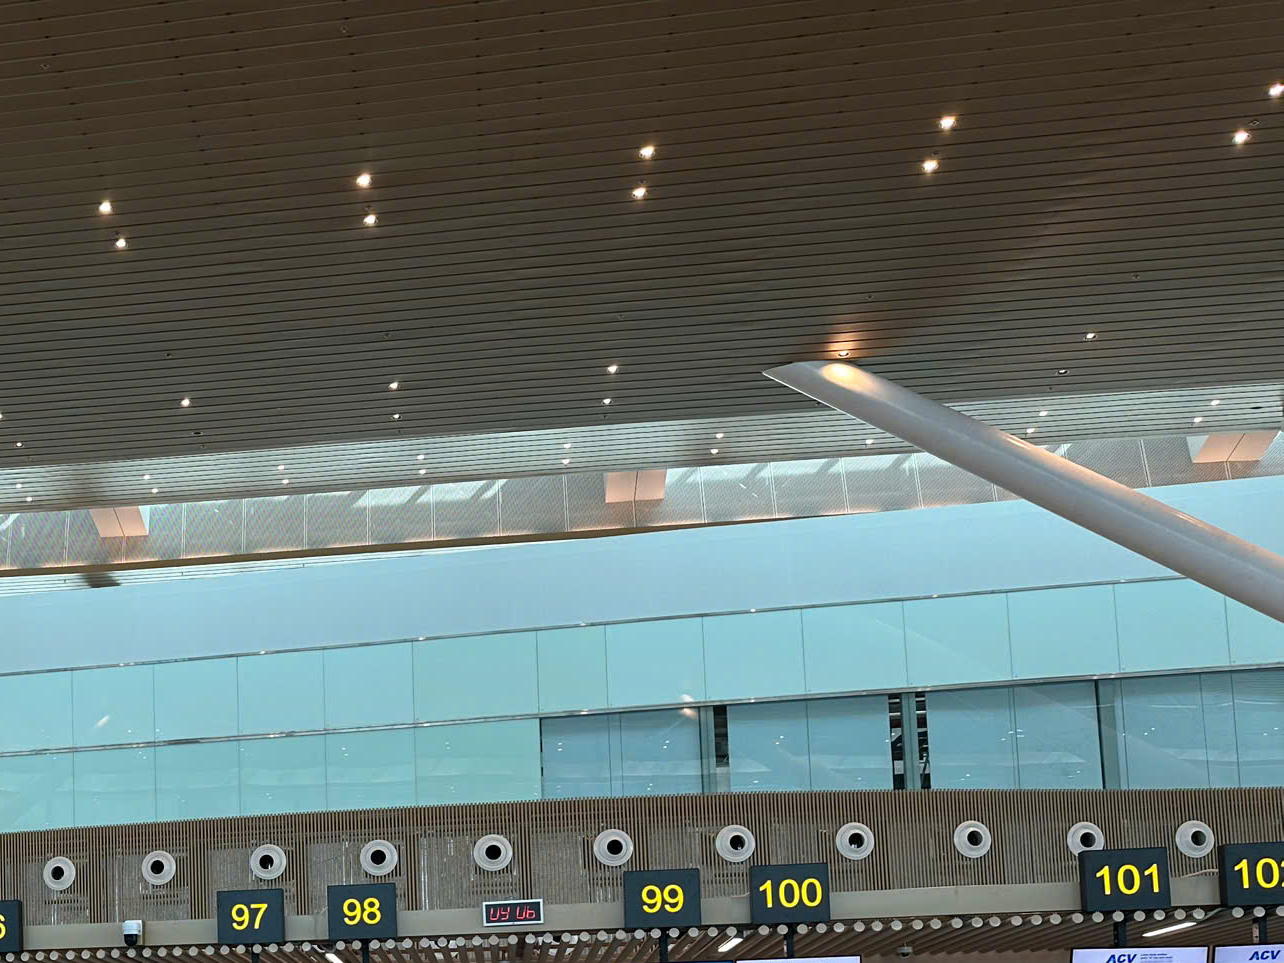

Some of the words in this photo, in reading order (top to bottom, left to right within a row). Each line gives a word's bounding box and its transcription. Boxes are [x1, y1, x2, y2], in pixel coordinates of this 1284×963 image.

[1095, 863, 1160, 895] 101
[1234, 857, 1284, 889] 10
[641, 884, 685, 914] 99
[759, 877, 823, 908] 100
[231, 903, 268, 931] 97
[343, 897, 381, 925] 98
[1106, 954, 1137, 963] ACV
[1249, 950, 1281, 960] ACV
